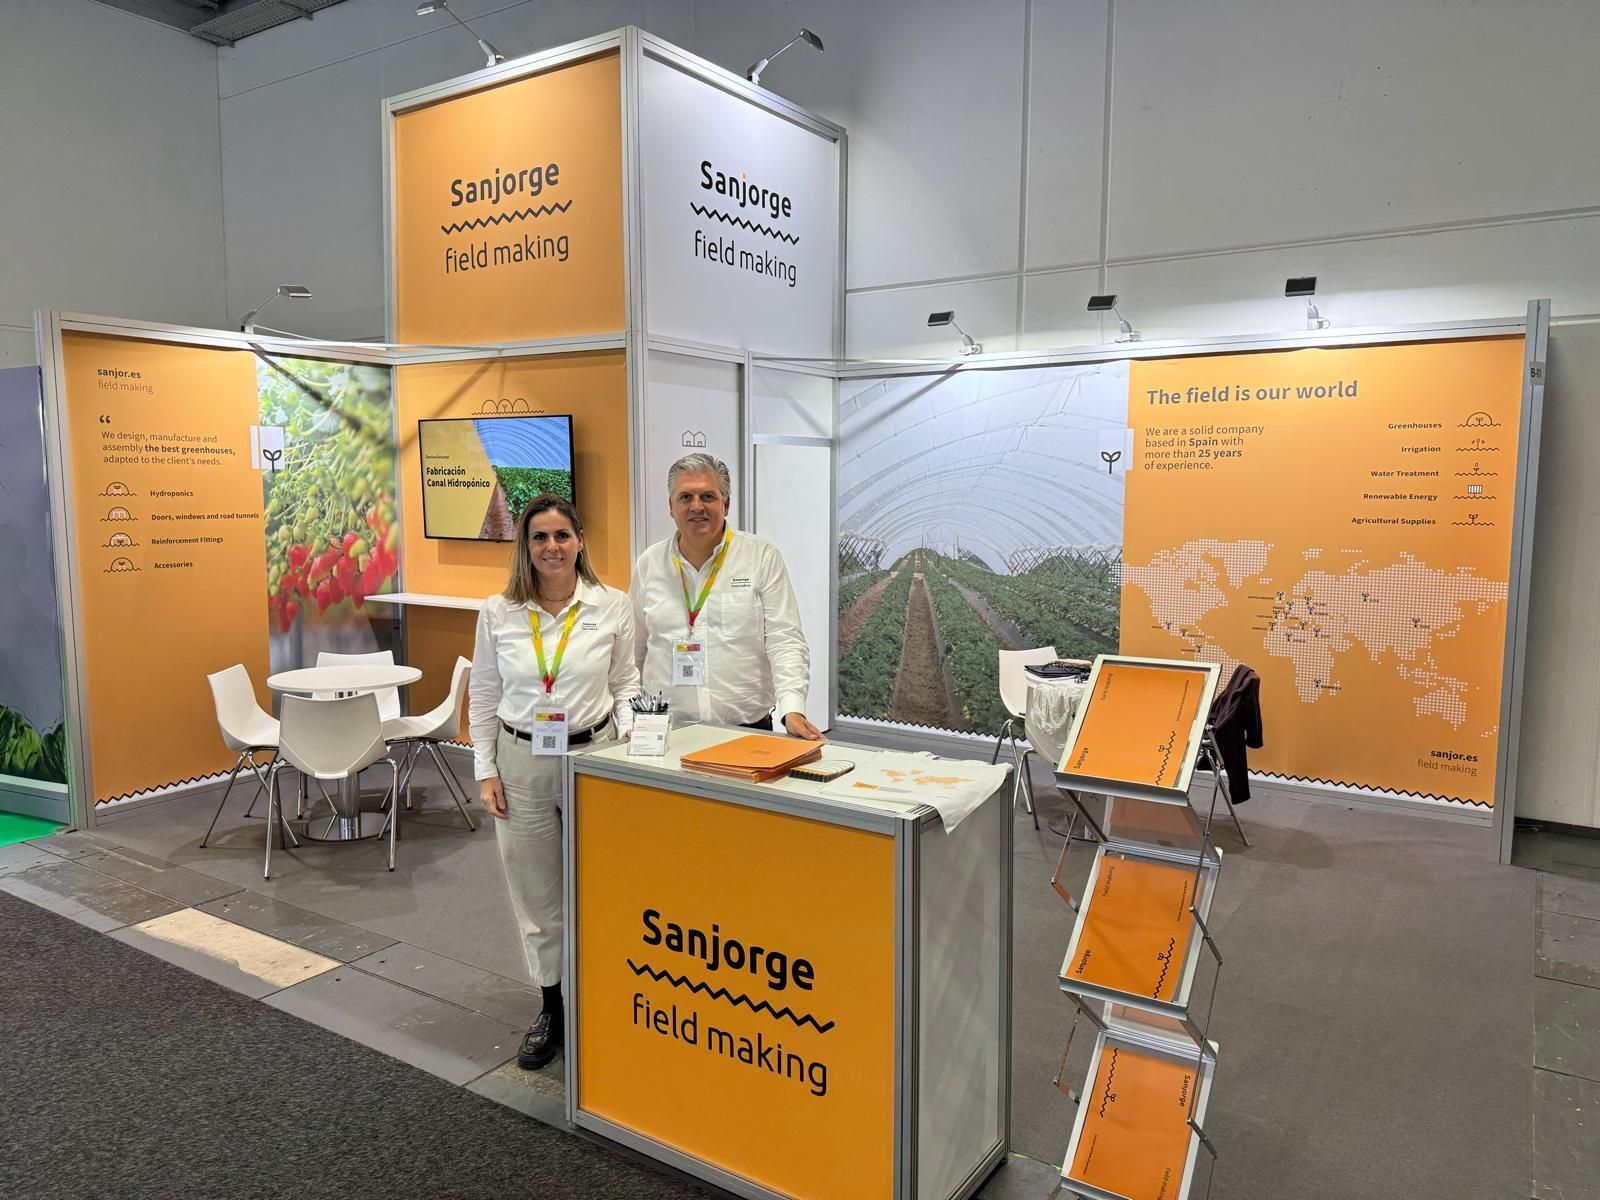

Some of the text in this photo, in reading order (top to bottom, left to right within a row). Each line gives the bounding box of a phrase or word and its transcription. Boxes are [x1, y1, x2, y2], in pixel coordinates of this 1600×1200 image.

[451, 163, 560, 207] Sanjorge
[701, 160, 792, 219] Sanjorge
[445, 234, 569, 274] field making
[695, 230, 797, 287] field making
[97, 368, 142, 379] sanjor.es
[98, 379, 154, 394] field making
[1147, 380, 1358, 405] The field is our world
[1145, 427, 1161, 436] We
[1162, 428, 1179, 436] are
[1189, 425, 1214, 435] solid
[1216, 425, 1264, 437] company
[1388, 422, 1442, 430] Greenhouses
[101, 431, 218, 443] We design, manufacture and
[1145, 436, 1244, 448] based in Spain with
[102, 444, 236, 456] assembly the best greenhouses,
[1145, 449, 1242, 460] more than 25 years
[104, 455, 139, 465] adapted
[151, 456, 165, 464] the
[167, 456, 195, 465] client's
[197, 457, 222, 466] needs.
[1145, 461, 1214, 472] of experience.
[426, 466, 466, 475] Fabricación
[427, 477, 490, 489] Canal Hidropónico
[150, 490, 194, 498] Hydroponics
[152, 514, 174, 522] Doors,
[175, 512, 205, 520] windows
[206, 512, 219, 520] and
[1352, 517, 1436, 526] Agricultural Supplies
[152, 536, 224, 545] Reinforcement Fittings
[154, 561, 193, 569] Accessories
[1430, 750, 1478, 762] sanjor.es
[1417, 759, 1478, 776] field making
[642, 908, 814, 991] Sanjorge
[633, 992, 827, 1097] field making
[1179, 1074, 1191, 1108] Sanjorge
